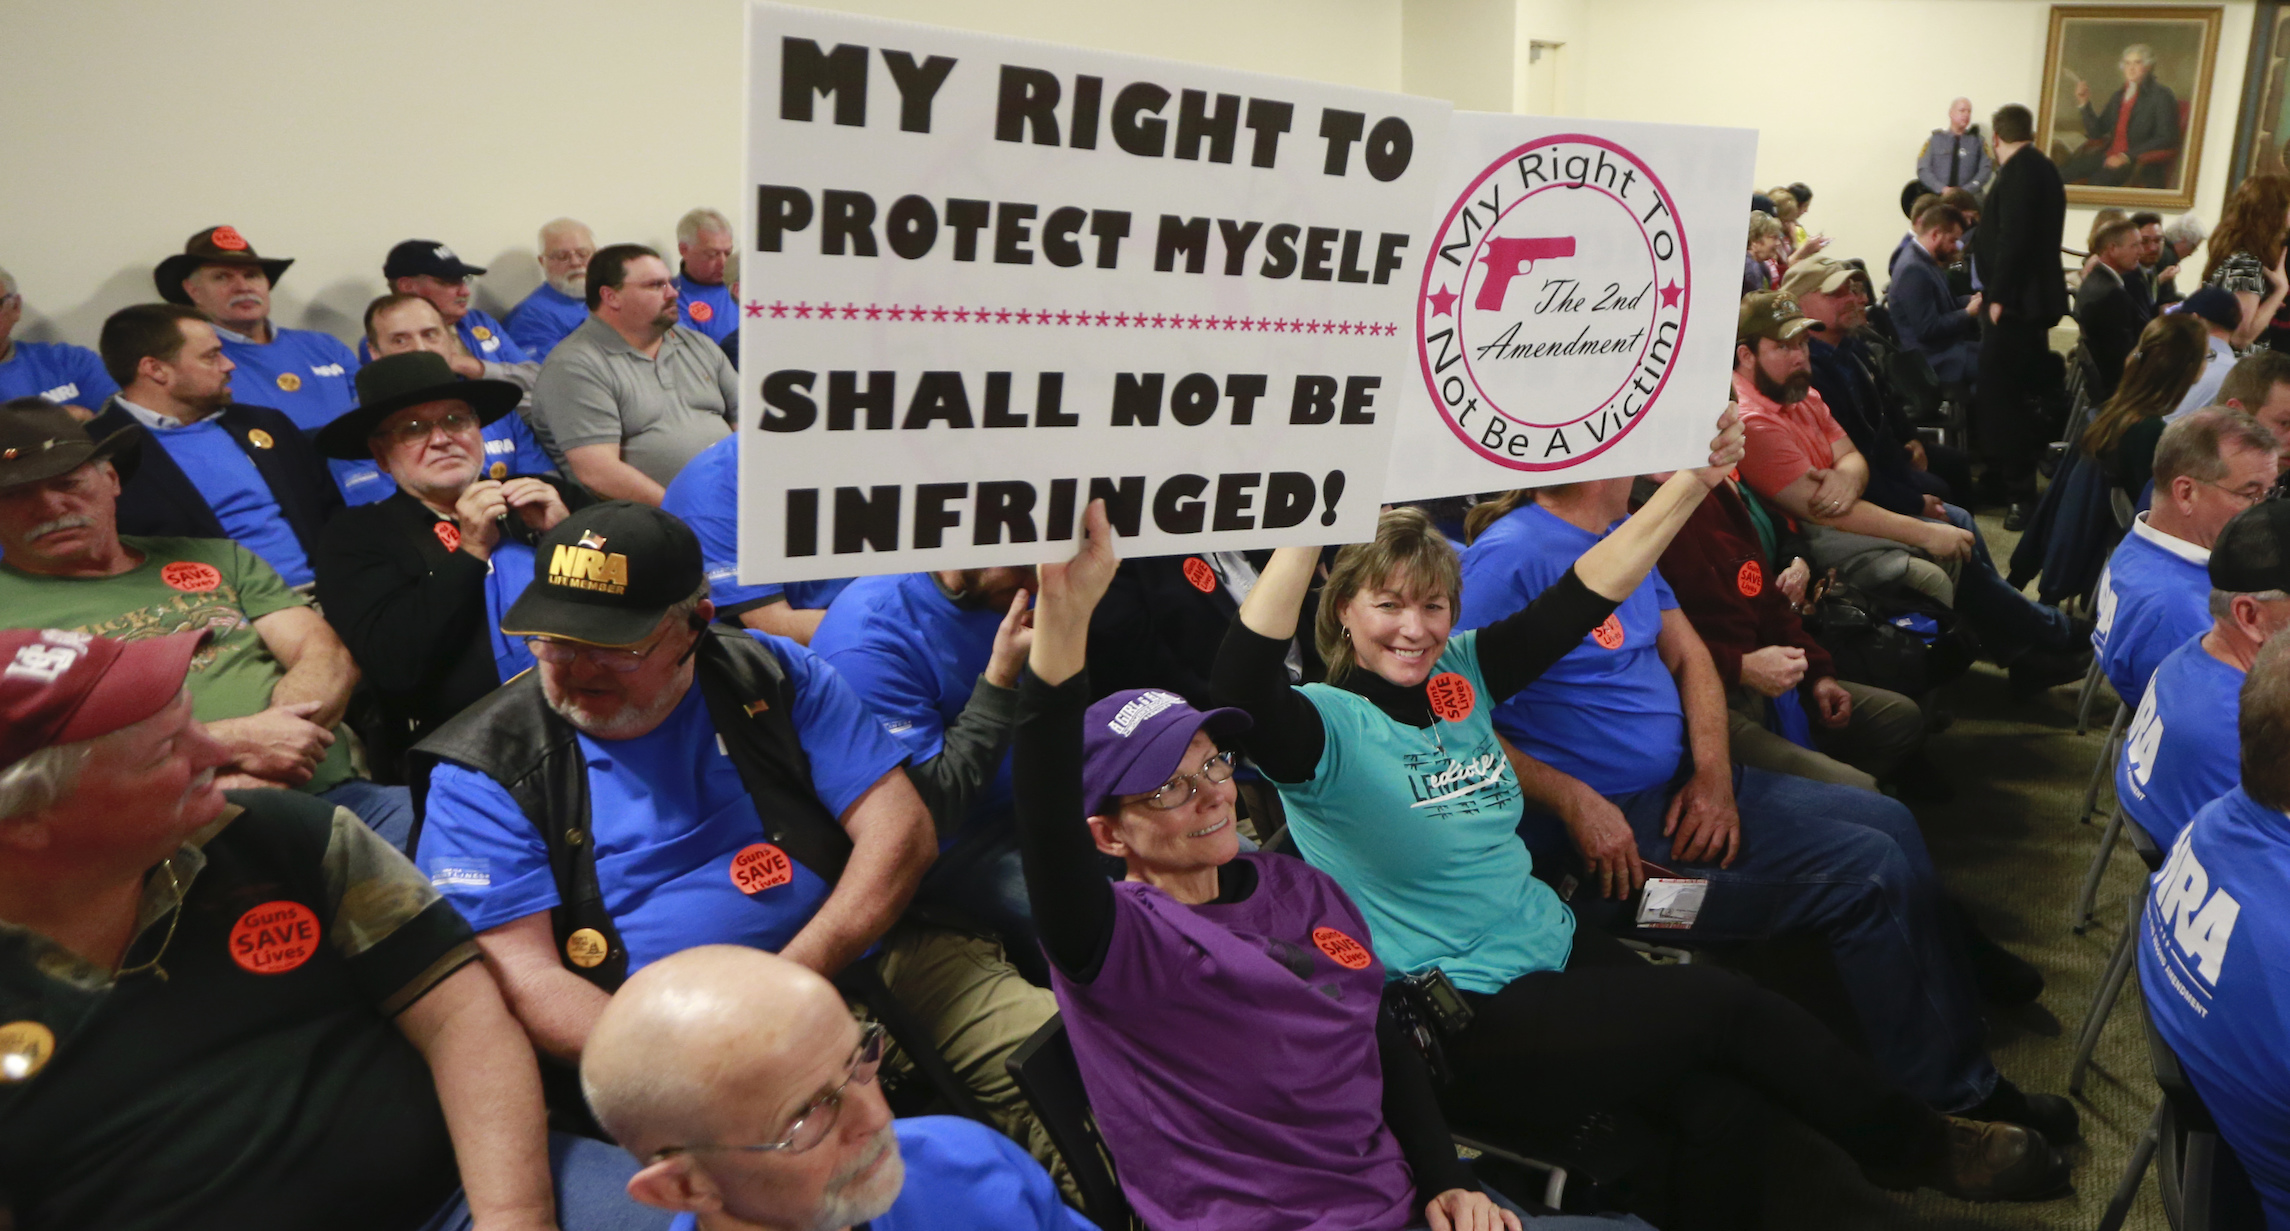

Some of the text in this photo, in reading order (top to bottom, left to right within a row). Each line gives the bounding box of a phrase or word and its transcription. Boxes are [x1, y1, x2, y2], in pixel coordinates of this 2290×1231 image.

[780, 36, 1414, 183] MY RIGHT TO
[1438, 147, 1675, 268] My Right To
[757, 184, 1410, 285] PROTECT MYSELF
[1534, 277, 1653, 315] The 2nd
[1476, 321, 1645, 362] Amendment
[758, 369, 1382, 433] SHALL NOT BE
[1426, 320, 1680, 459] Not Be A Victim
[785, 469, 1347, 559] INFRINGED!
[167, 569, 215, 585] SAVE
[548, 543, 629, 586] NRA
[1190, 562, 1208, 586] SAVE
[1740, 570, 1761, 587] SAVE
[182, 579, 215, 591] Lives
[569, 577, 625, 595] MEMBER
[1429, 686, 1445, 715] Guns
[1435, 676, 1460, 719] SAVE
[1455, 679, 1470, 710] Lives
[1115, 700, 1143, 727] GIRL
[735, 847, 771, 866] Guns
[736, 854, 787, 886] SAVE
[751, 874, 786, 891] Lives
[243, 907, 298, 928] Guns
[2153, 820, 2241, 988] NRA
[236, 919, 313, 955] SAVE
[1314, 931, 1341, 941] Guns
[1321, 938, 1360, 956] SAVE
[252, 945, 306, 967] Lives
[1339, 952, 1367, 964] Lives
[2164, 964, 2209, 1019] AMENDMENT
